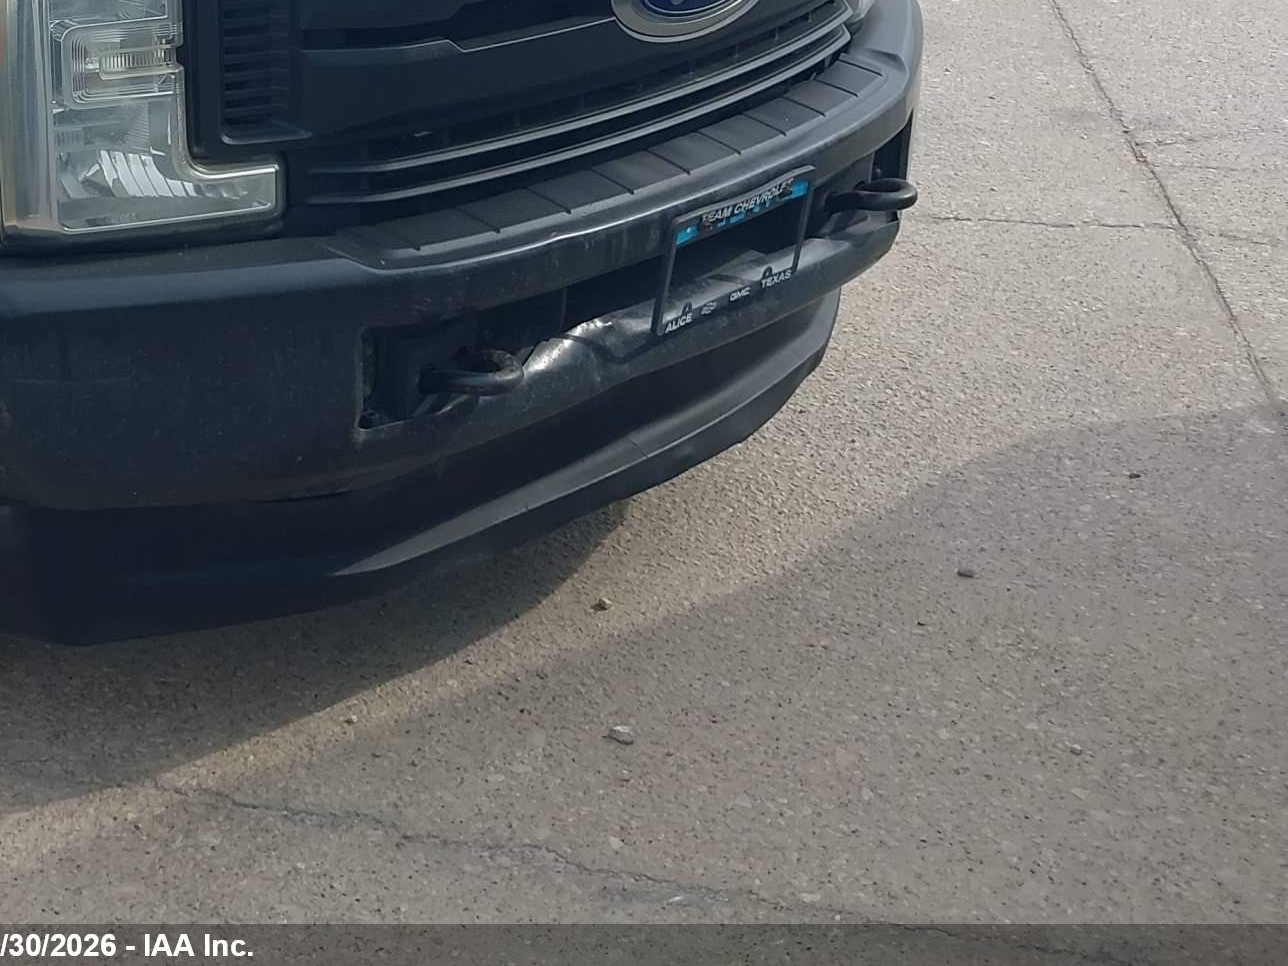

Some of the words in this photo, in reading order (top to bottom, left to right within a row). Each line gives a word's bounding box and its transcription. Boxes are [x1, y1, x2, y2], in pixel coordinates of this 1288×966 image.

[665, 313, 693, 334] ALICE
[729, 287, 751, 301] GMC
[760, 269, 792, 289] TEXAS
